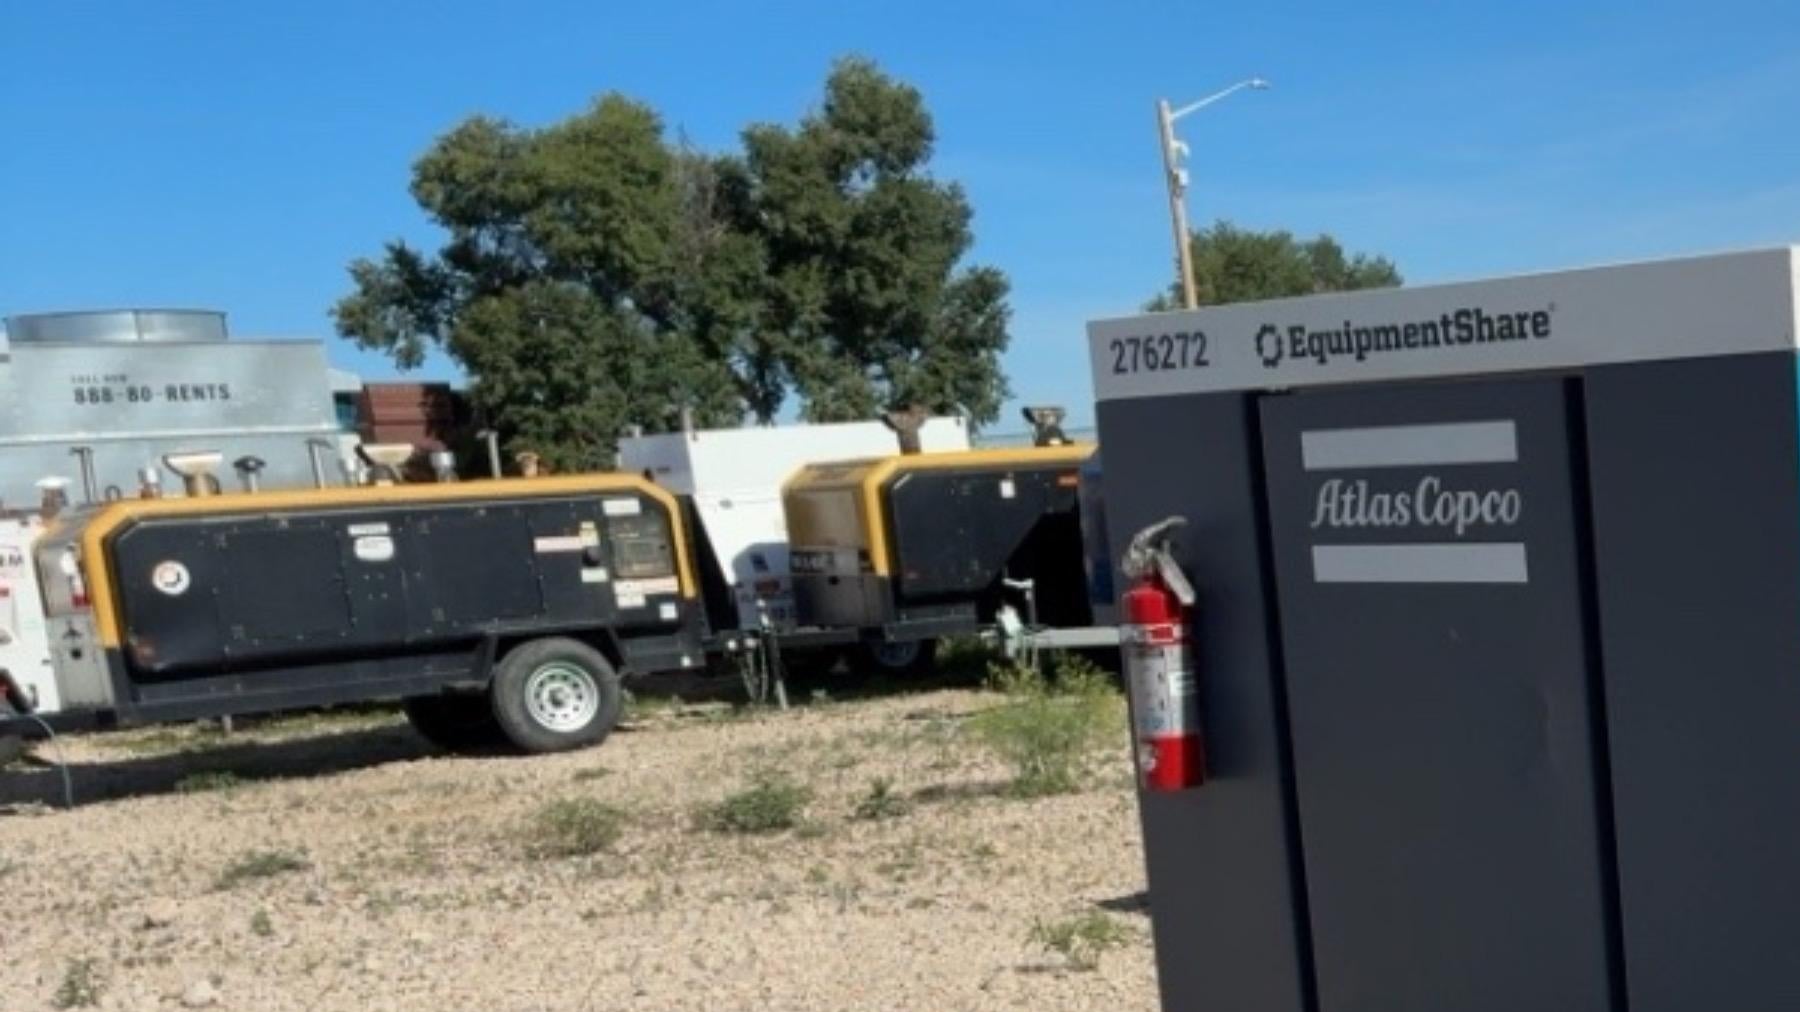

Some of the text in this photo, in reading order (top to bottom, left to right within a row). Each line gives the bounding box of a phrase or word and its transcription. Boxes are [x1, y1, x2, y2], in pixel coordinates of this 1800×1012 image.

[1110, 332, 1209, 374] 276272
[1288, 308, 1551, 364] EquipmentShare
[1310, 476, 1521, 536] Atlas Copco
